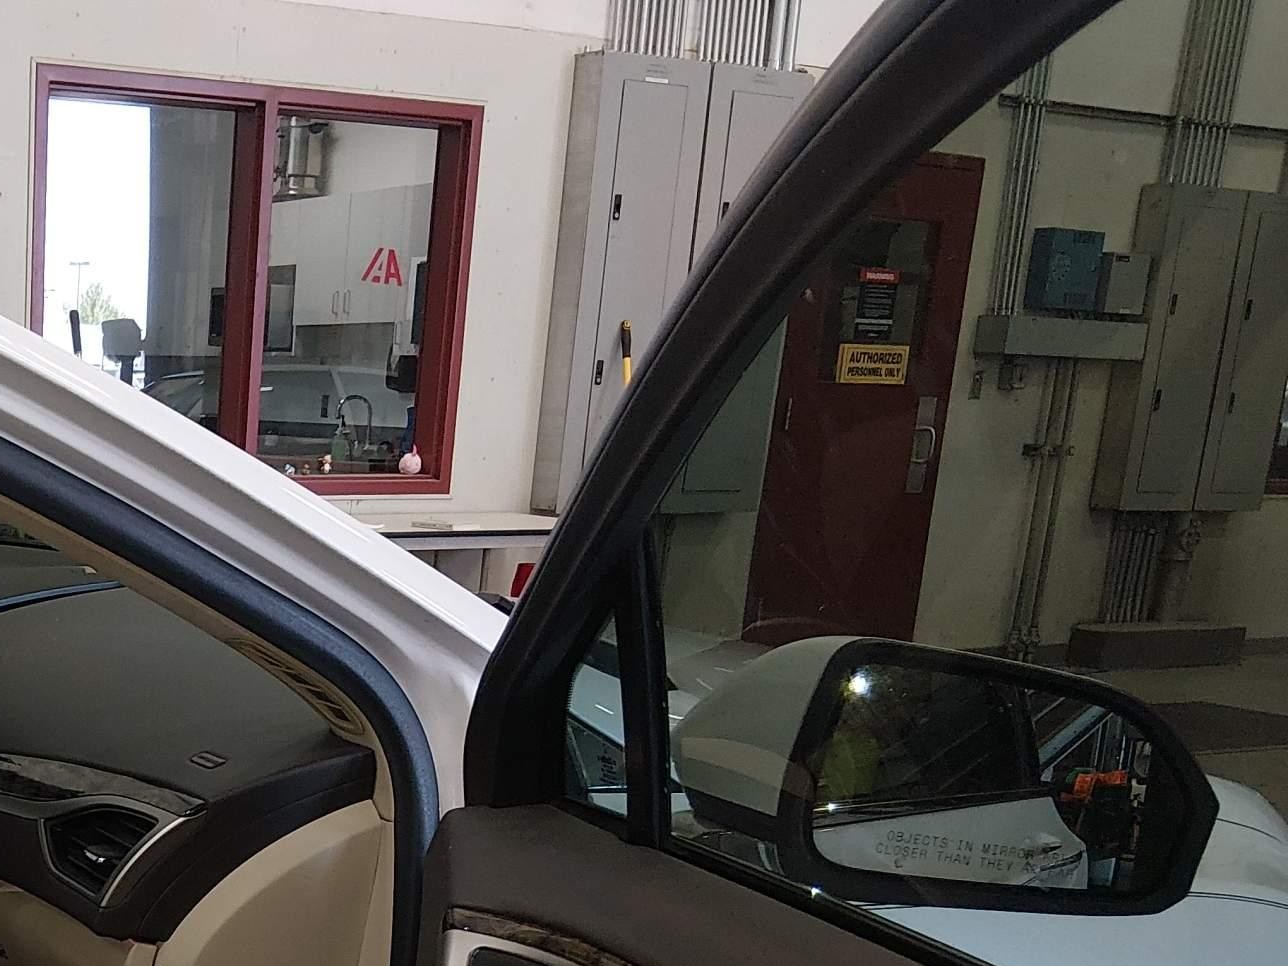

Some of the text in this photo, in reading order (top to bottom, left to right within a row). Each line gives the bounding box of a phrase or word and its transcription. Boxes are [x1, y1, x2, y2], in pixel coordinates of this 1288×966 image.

[849, 351, 903, 365] AUTHORIZED
[847, 366, 901, 378] PERSONNEL ONLY
[886, 829, 949, 849] OBJECTS
[958, 839, 974, 852] IN
[981, 843, 1033, 860] MIRROR
[874, 842, 928, 860] CLOSER
[937, 850, 972, 866] THAN
[979, 857, 1014, 871] THEY
